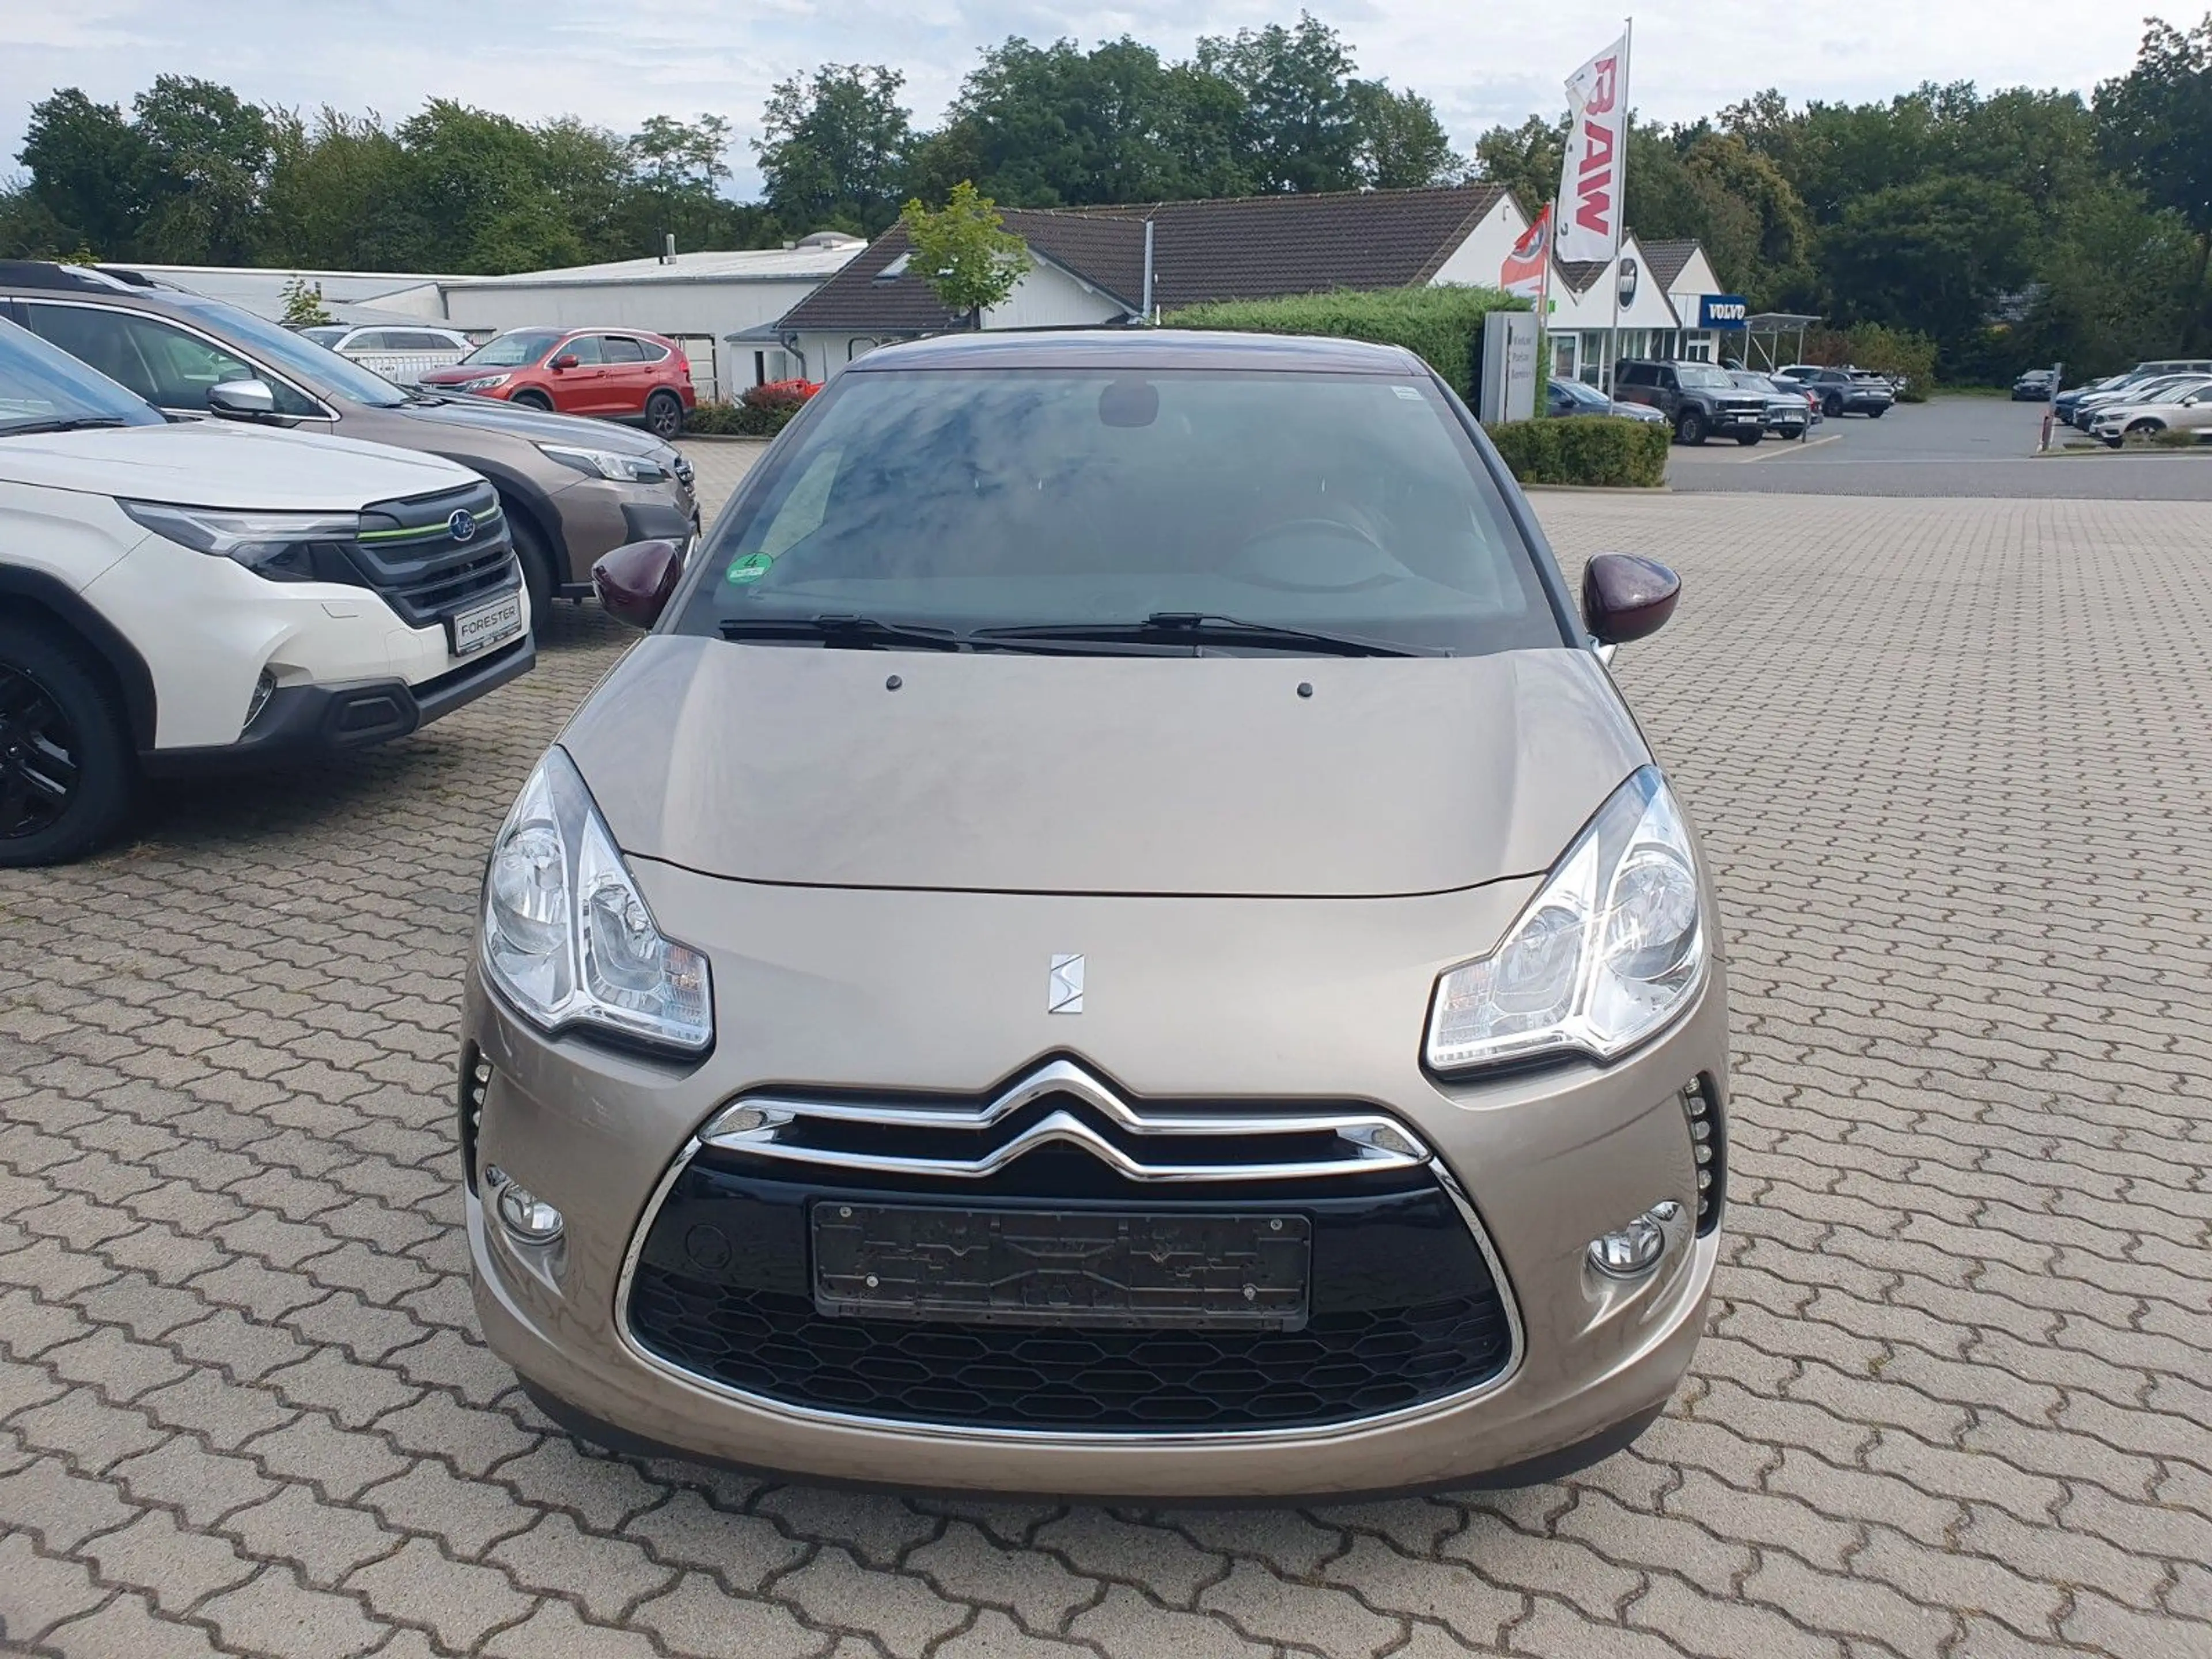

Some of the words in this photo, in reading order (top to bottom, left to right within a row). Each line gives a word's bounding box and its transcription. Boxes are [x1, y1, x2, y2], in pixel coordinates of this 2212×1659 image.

[1708, 303, 1745, 320] VOLVO
[744, 554, 757, 567] 4
[461, 606, 516, 637] FORESTER
